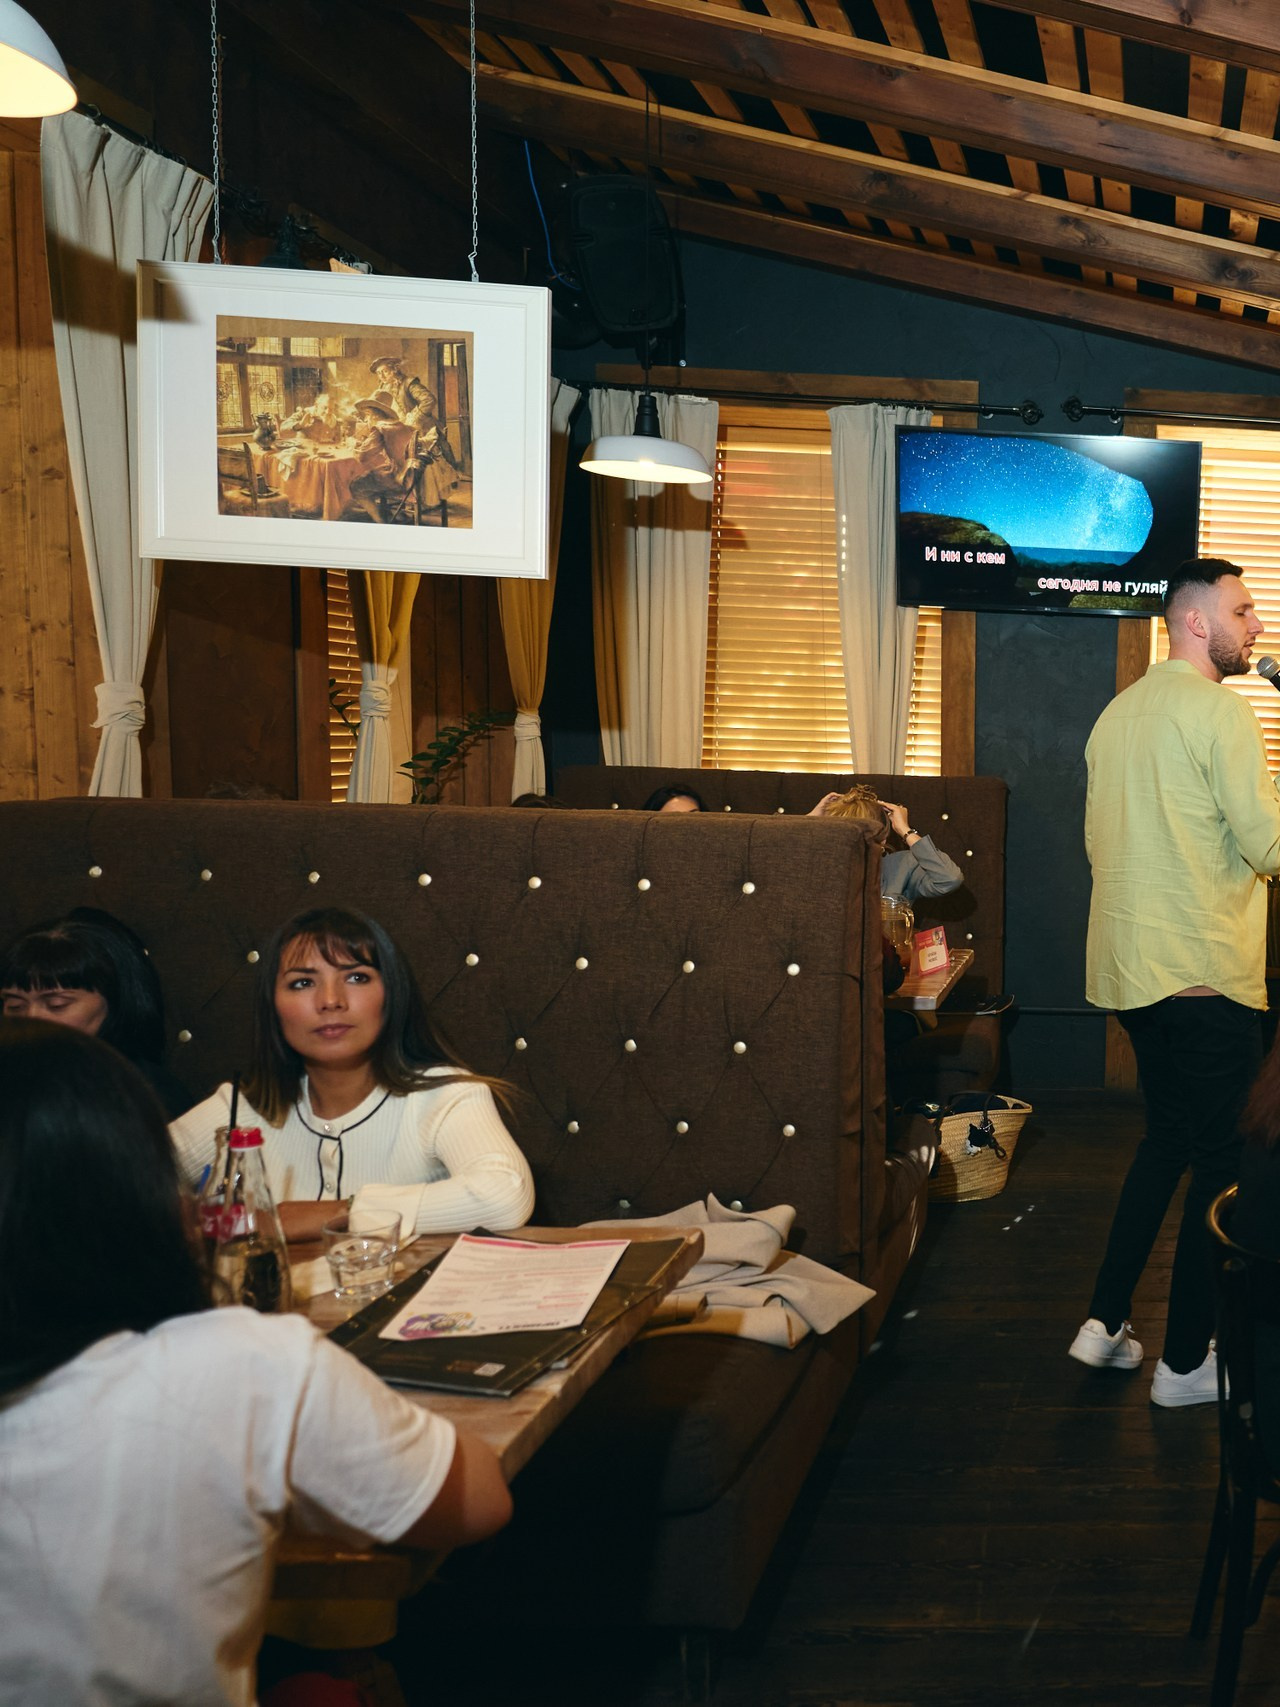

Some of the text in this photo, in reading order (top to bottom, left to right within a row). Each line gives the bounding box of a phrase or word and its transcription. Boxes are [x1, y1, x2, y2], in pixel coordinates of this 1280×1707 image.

[925, 547, 1006, 564] И ни с кем
[1038, 577, 1168, 596] сегодня не гуляй
